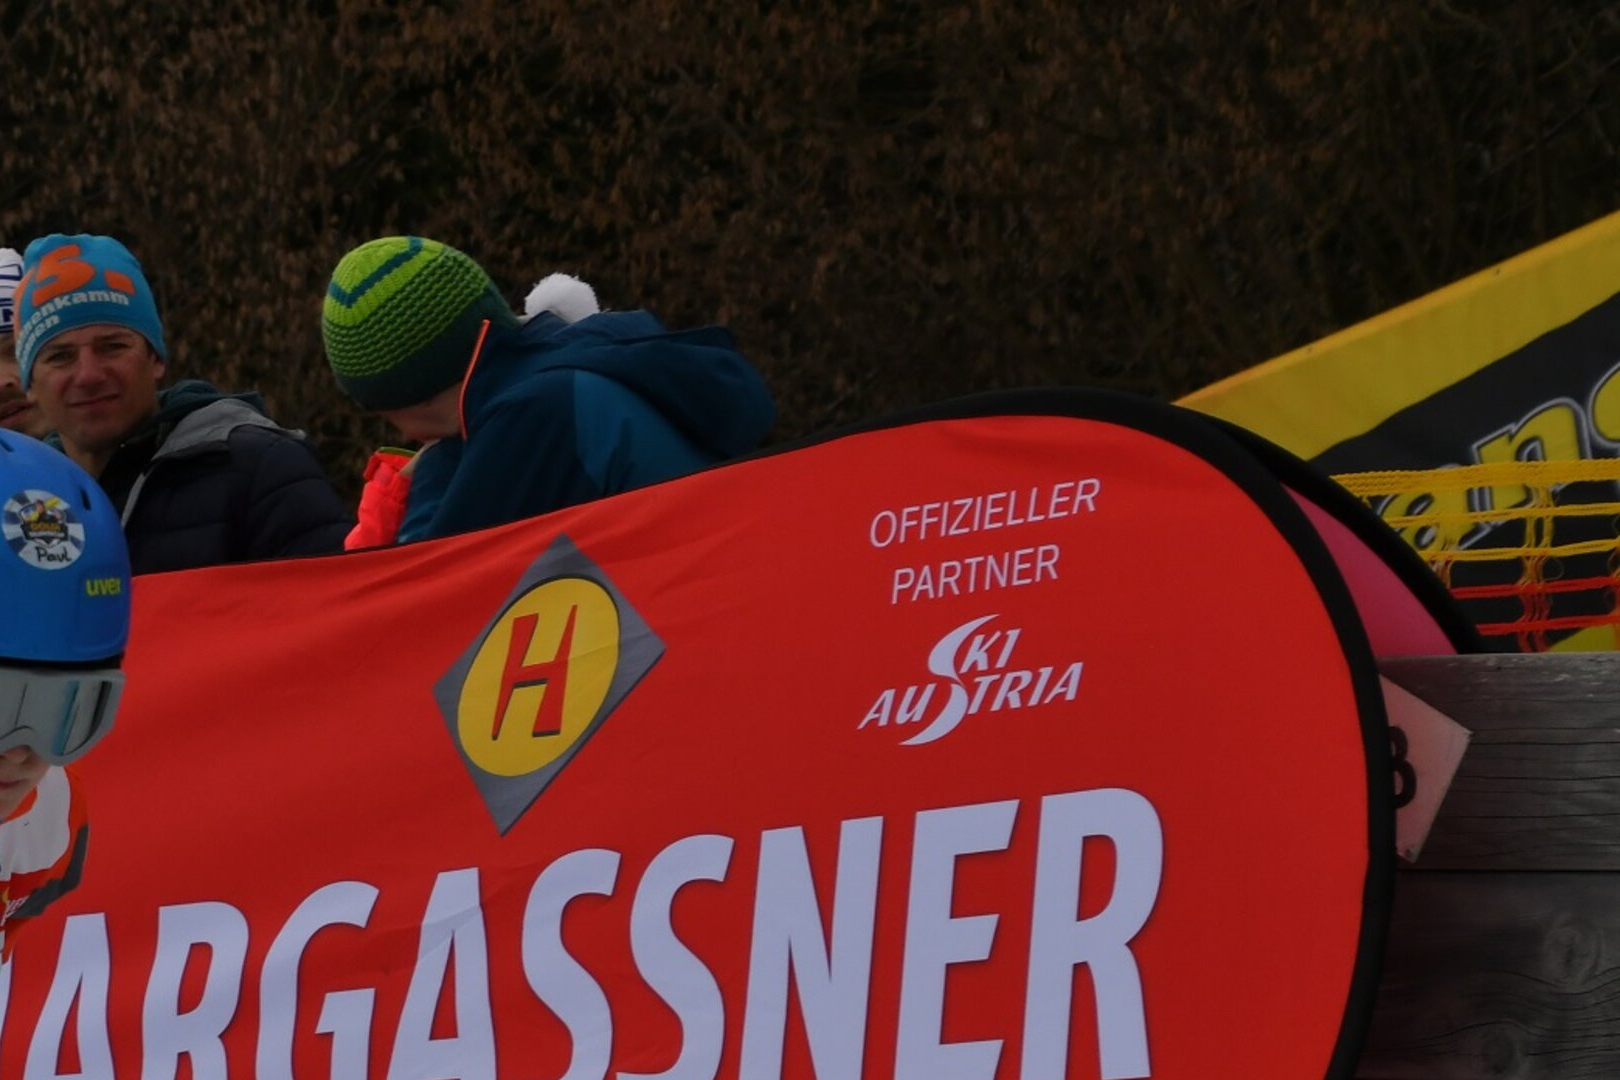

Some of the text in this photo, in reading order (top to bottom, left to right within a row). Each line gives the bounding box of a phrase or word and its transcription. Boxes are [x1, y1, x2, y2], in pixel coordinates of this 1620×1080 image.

[869, 477, 1101, 548] OFFIZIELLER
[35, 546, 72, 562] Paul
[891, 543, 1060, 605] PARTNER
[492, 604, 578, 741] H
[856, 661, 1084, 746] AUSTRIA
